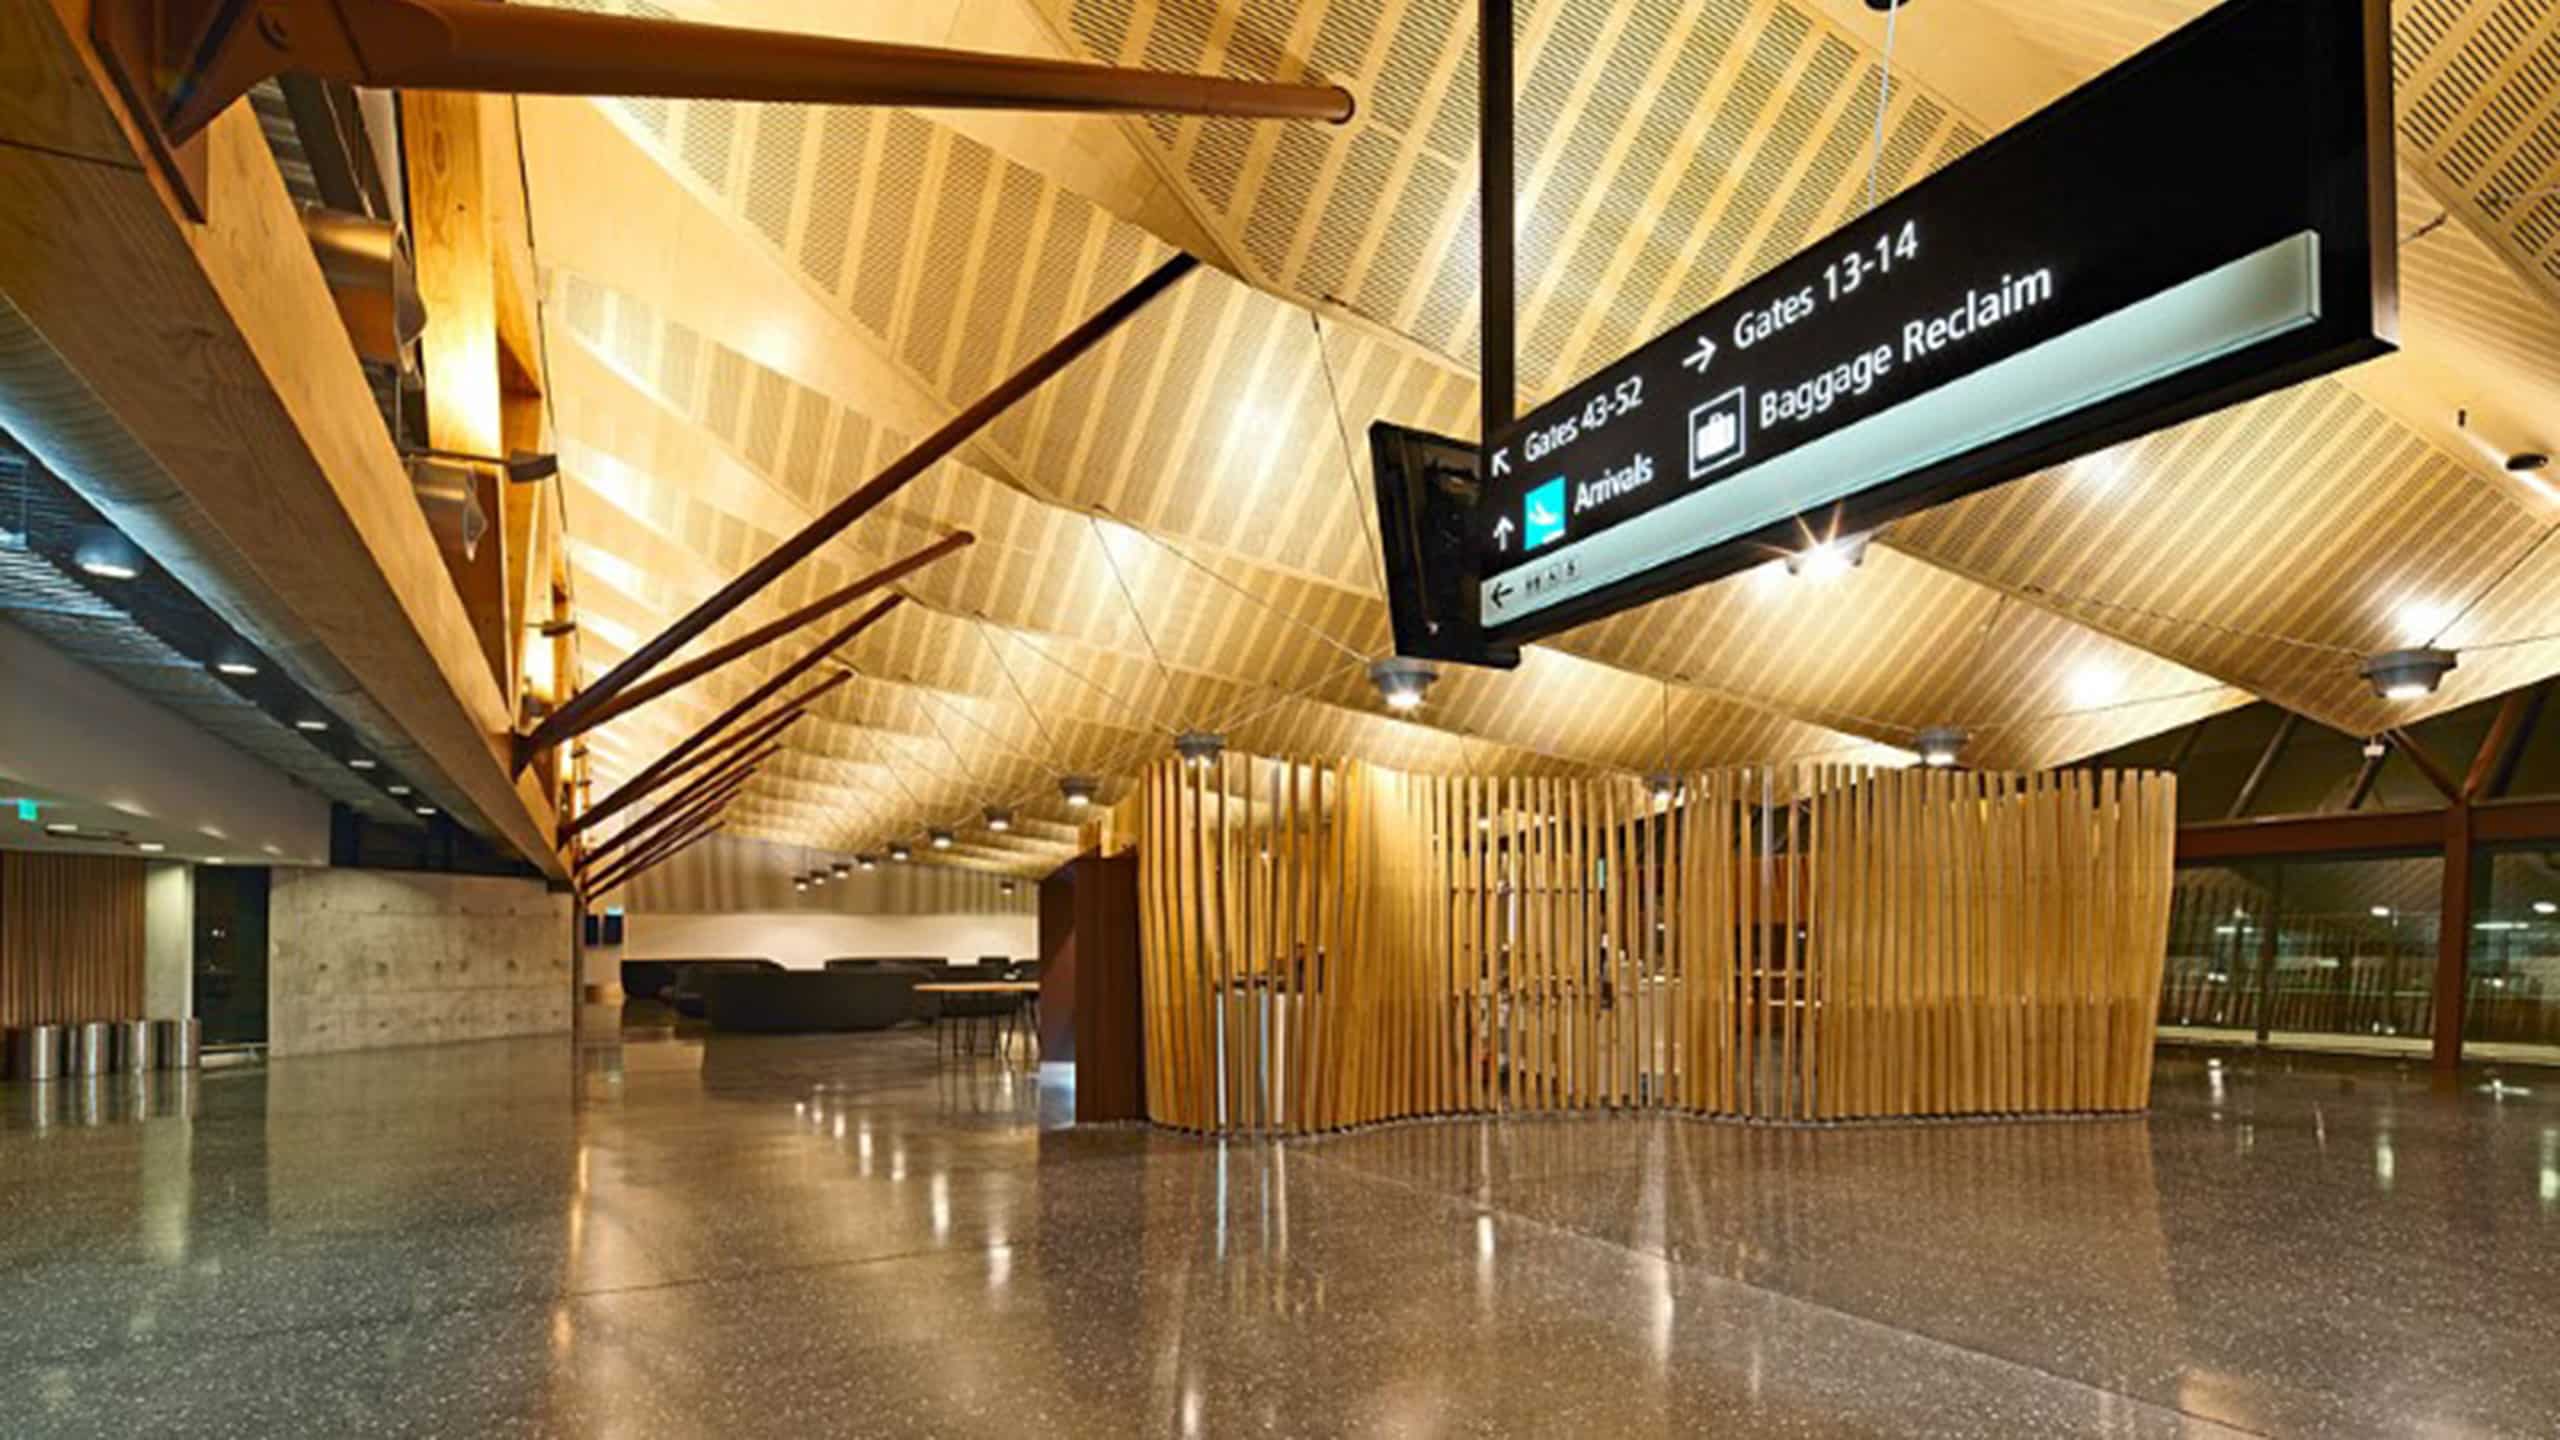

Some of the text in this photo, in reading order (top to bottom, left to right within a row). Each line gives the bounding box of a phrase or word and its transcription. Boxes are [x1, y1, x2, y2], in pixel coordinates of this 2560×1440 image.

[1733, 220, 1919, 350] Gates 13-14
[1759, 268, 2052, 429] Baggage Reclaim
[1524, 375, 1643, 462] Gates 43-52
[1573, 452, 1655, 514] Arrivals
